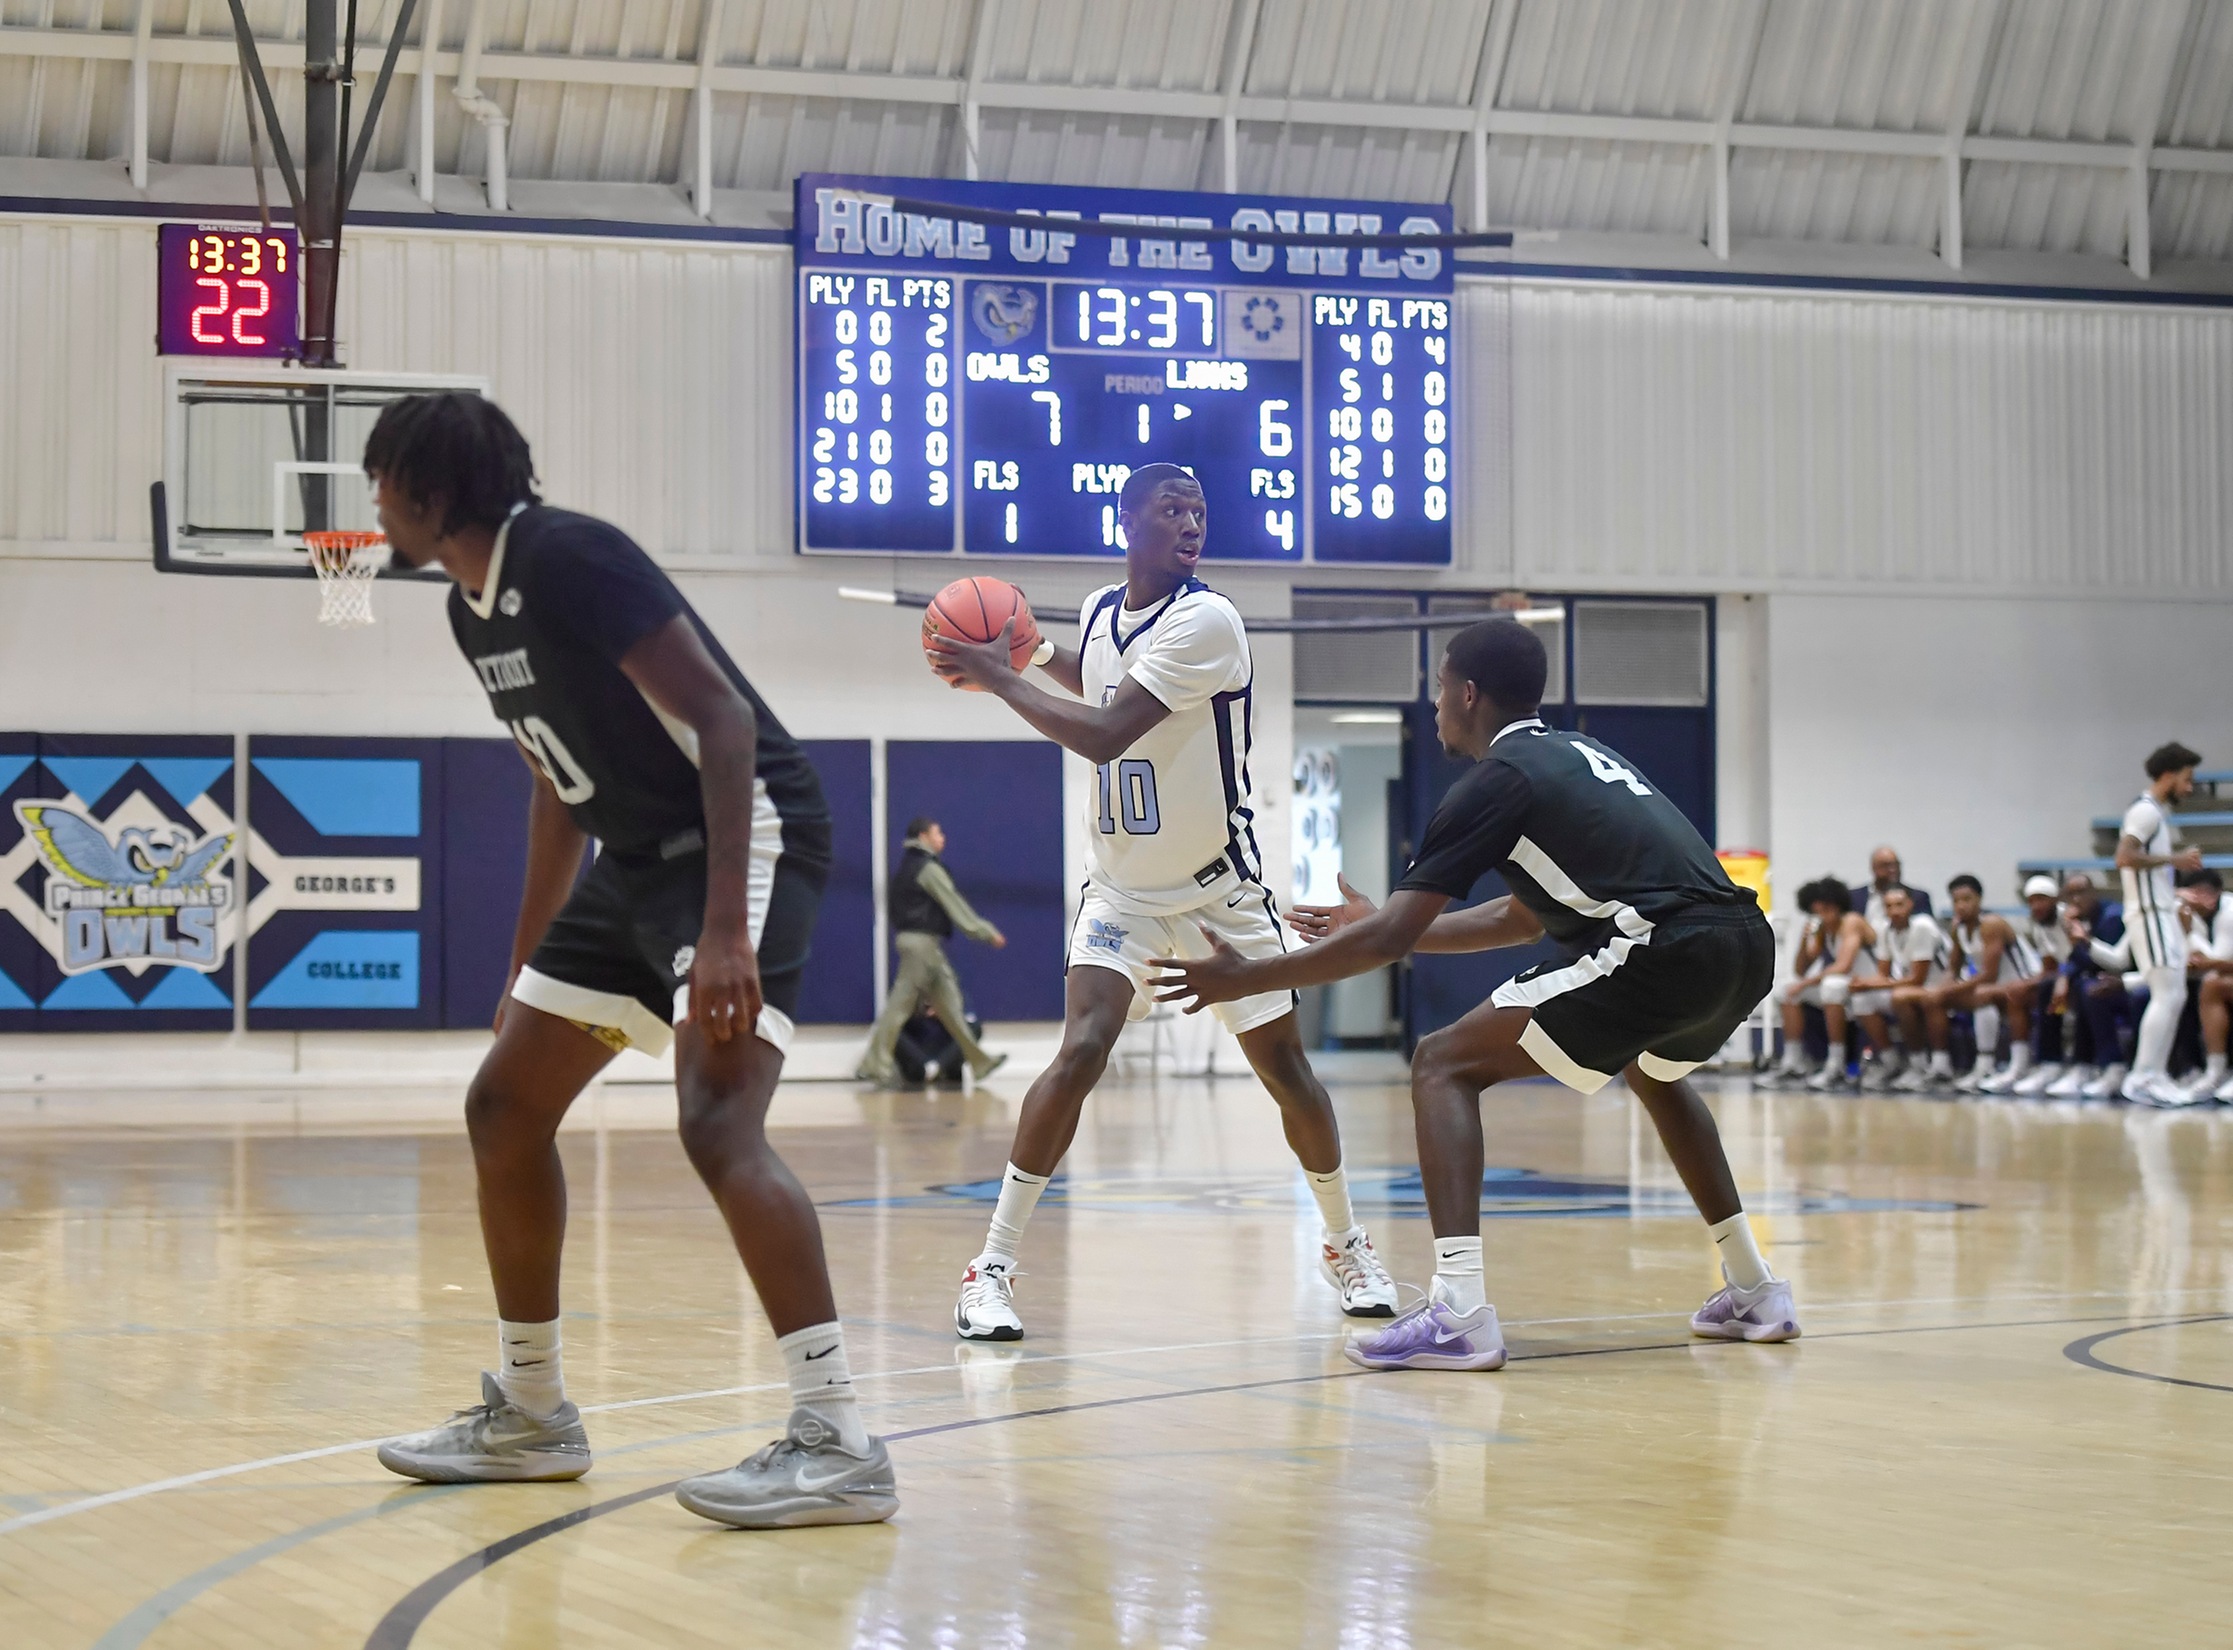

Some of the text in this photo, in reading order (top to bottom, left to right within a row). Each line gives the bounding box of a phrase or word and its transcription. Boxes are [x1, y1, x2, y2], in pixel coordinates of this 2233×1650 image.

[815, 188, 1442, 281] HOME OF THE OWLS
[190, 236, 286, 275] 13:37
[192, 278, 269, 344] 22
[810, 275, 950, 309] PLY FL PTS
[836, 310, 948, 348] 0 0 2
[1079, 290, 1213, 348] 13:37
[1315, 297, 1448, 330] PLY FL PTS
[1339, 331, 1446, 366] 4 0 4
[836, 349, 948, 388] 5 0 0
[966, 353, 1049, 383] OWLS
[1105, 374, 1164, 395] PERIOD
[1339, 368, 1446, 406] 5 1 0
[825, 389, 948, 427] 10 1 0
[1031, 391, 1061, 446] 7
[1138, 404, 1149, 444] 1
[1330, 406, 1446, 444] 10 0 0
[1260, 399, 1293, 457] 6
[870, 429, 892, 465] 0
[926, 431, 948, 467] 0
[1330, 444, 1446, 483] 12 1 0
[813, 467, 948, 506] 23 0 3
[974, 460, 1019, 490] FLS
[1250, 468, 1295, 499] FLS
[1330, 483, 1446, 521] 15 0 0
[1006, 503, 1017, 543] 1
[1265, 510, 1294, 551] 4
[1569, 741, 1653, 796] 4
[1097, 759, 1161, 835] 10
[295, 876, 395, 894] GEORGE'S
[64, 906, 217, 968] OWLS
[307, 962, 402, 980] COLLEGE
